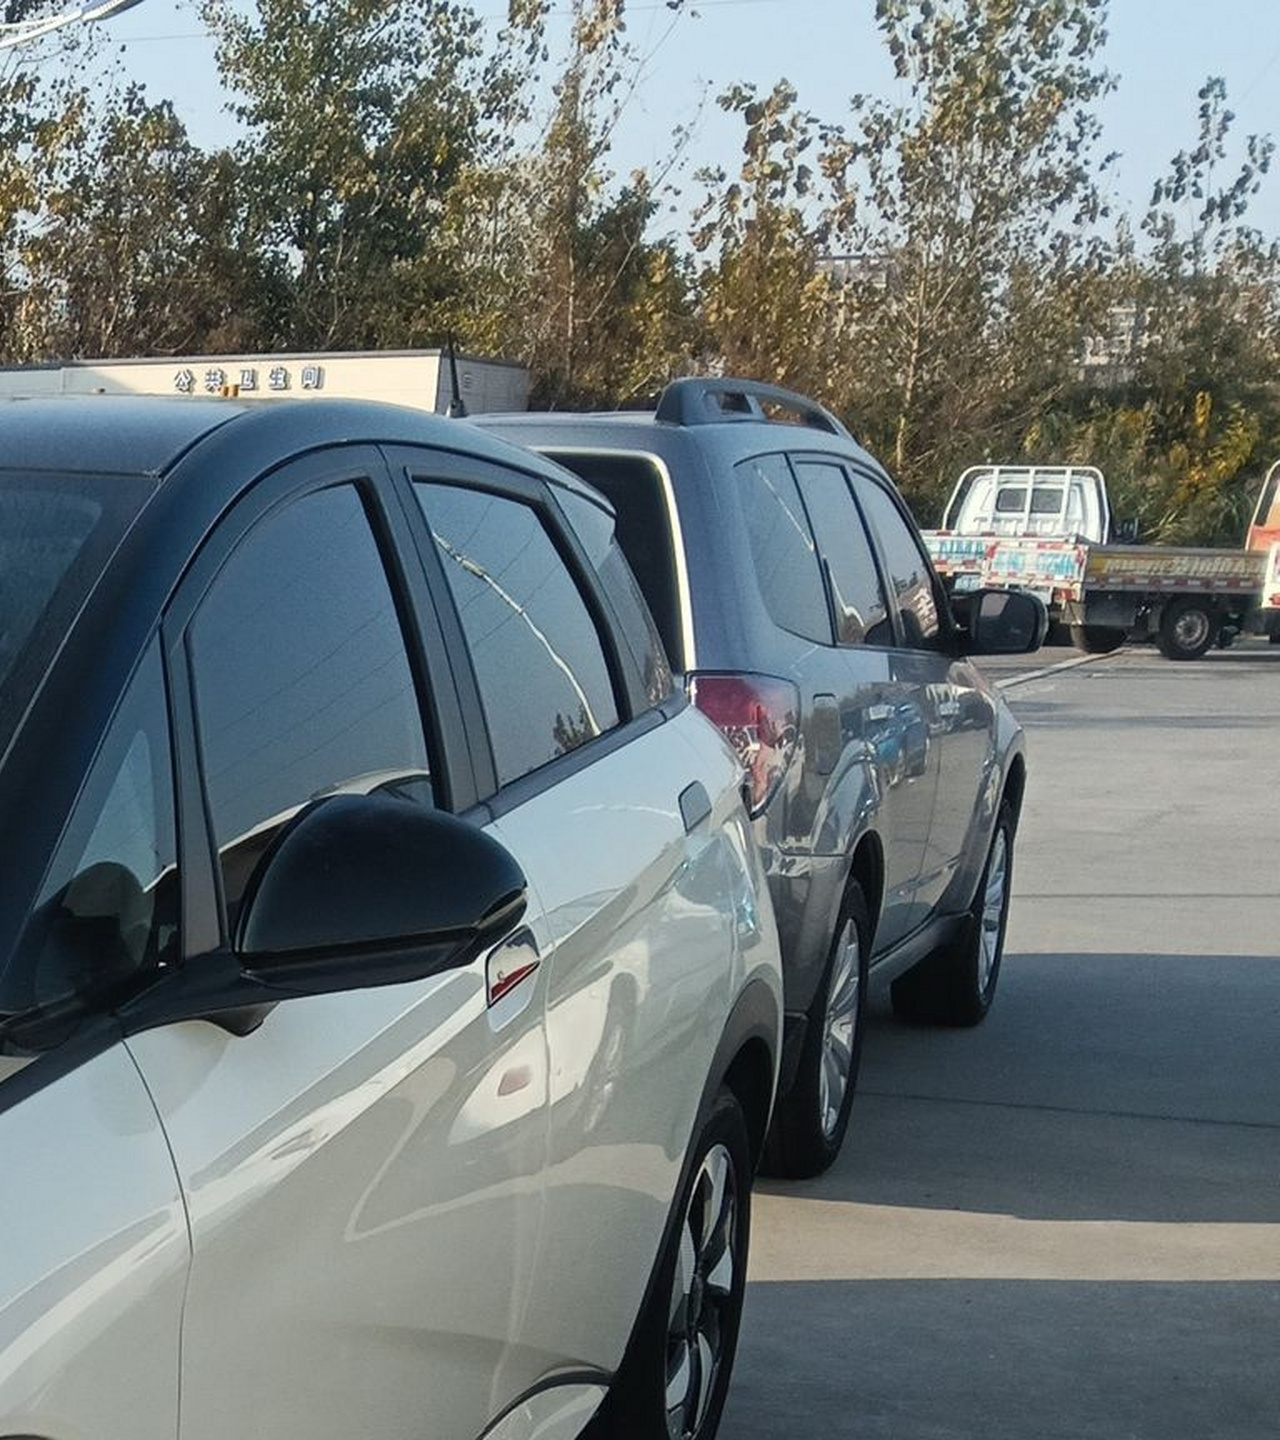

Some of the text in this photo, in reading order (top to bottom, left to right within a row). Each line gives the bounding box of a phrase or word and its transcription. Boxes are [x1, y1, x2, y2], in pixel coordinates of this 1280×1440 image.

[174, 366, 324, 392] 公共卫生间
